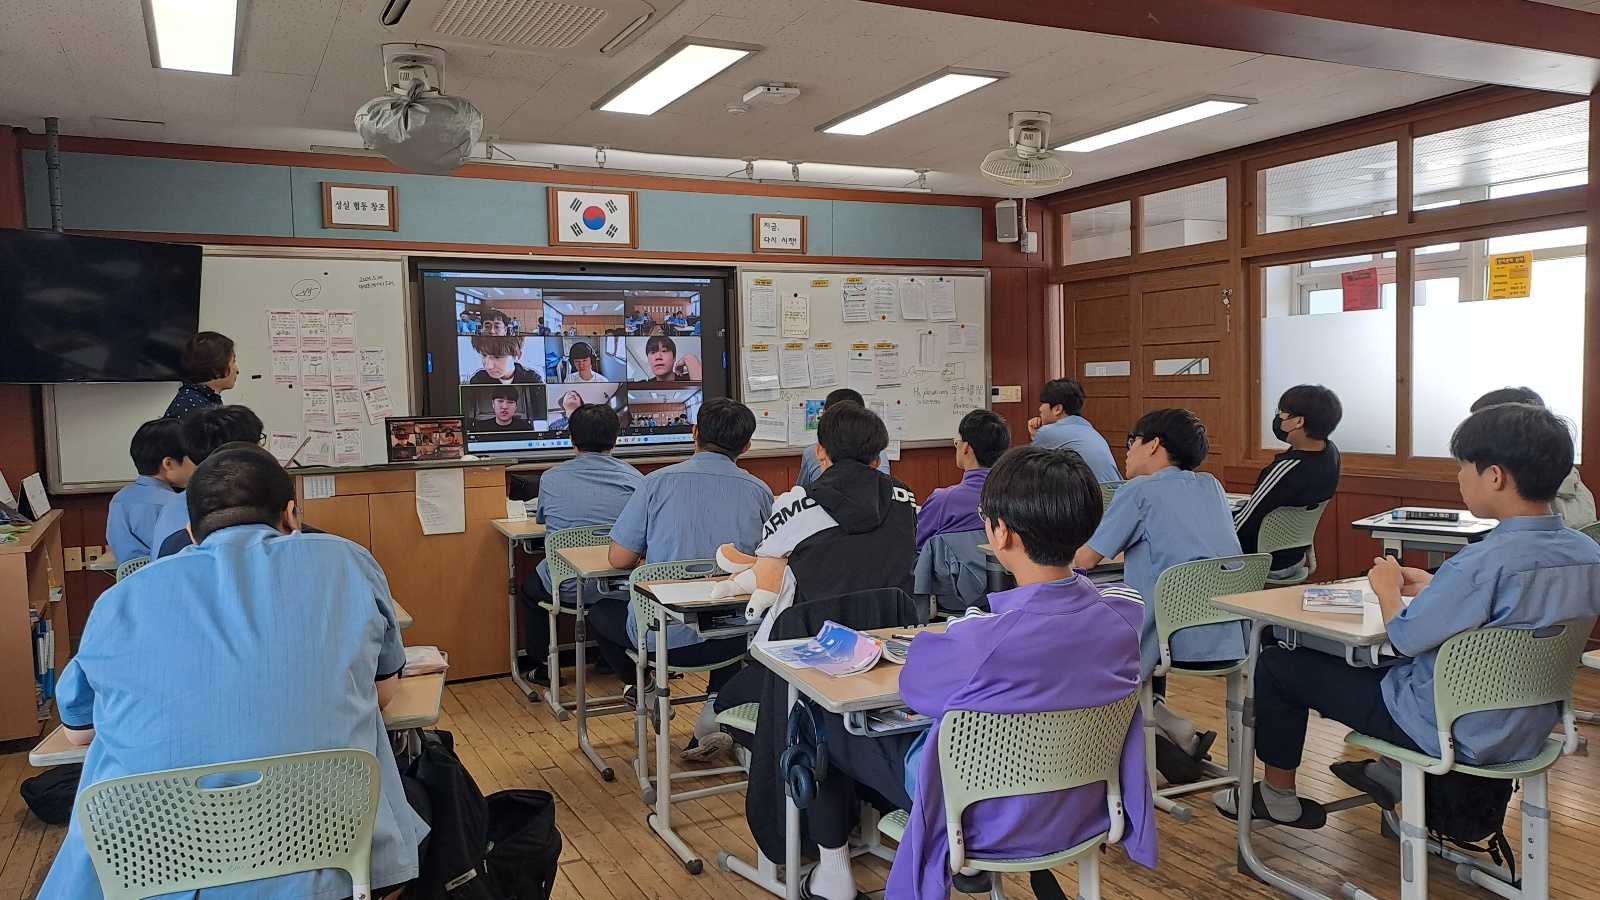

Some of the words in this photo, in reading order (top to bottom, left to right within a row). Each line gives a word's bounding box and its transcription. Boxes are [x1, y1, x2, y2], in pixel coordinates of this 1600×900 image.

[335, 200, 350, 210] 성실
[353, 201, 368, 211] 협동
[371, 202, 386, 211] 창조
[764, 222, 780, 231] 지금,
[764, 236, 777, 244] 다시
